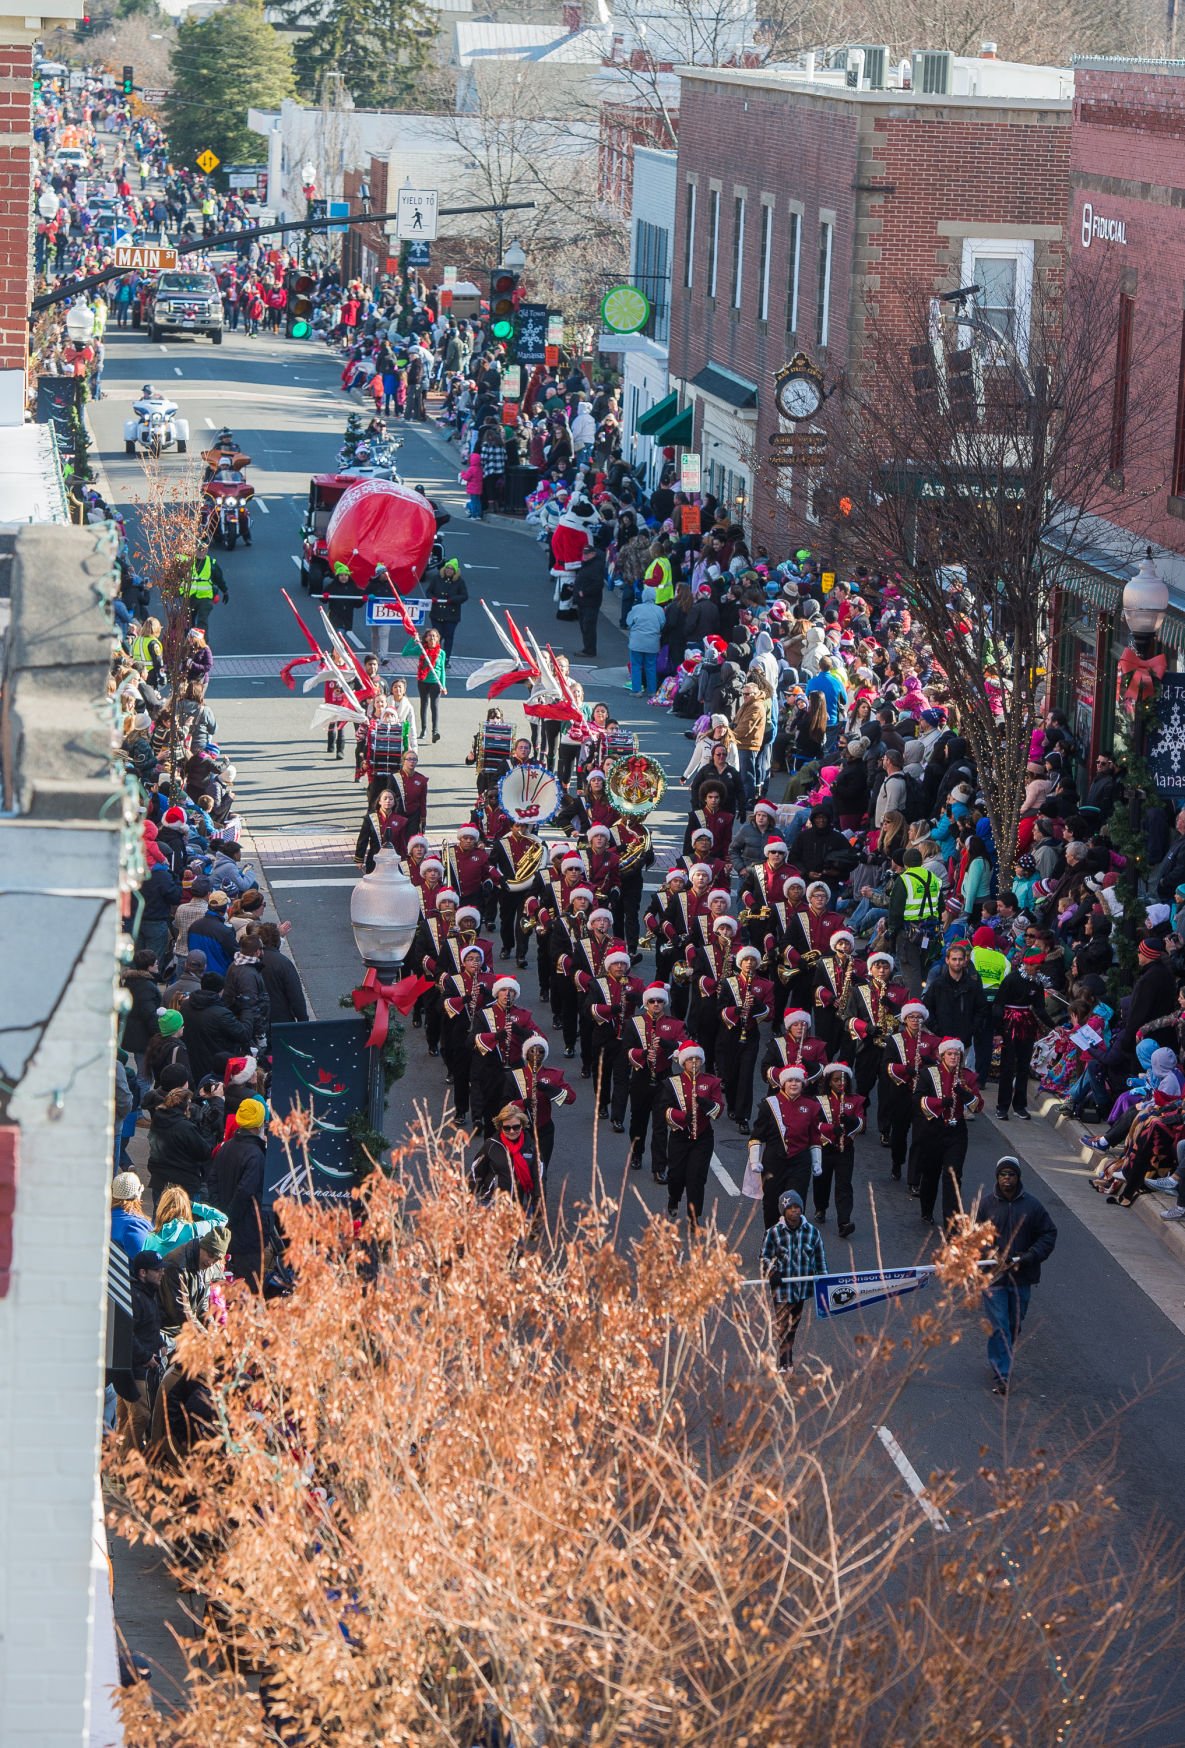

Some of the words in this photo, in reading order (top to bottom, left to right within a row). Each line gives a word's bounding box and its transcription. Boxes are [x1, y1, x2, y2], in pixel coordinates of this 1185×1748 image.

[402, 196, 423, 205] YIELD
[426, 197, 435, 206] TO
[1093, 215, 1126, 244] FIDUCIAL
[118, 248, 160, 268] MAIN
[165, 251, 175, 259] ST
